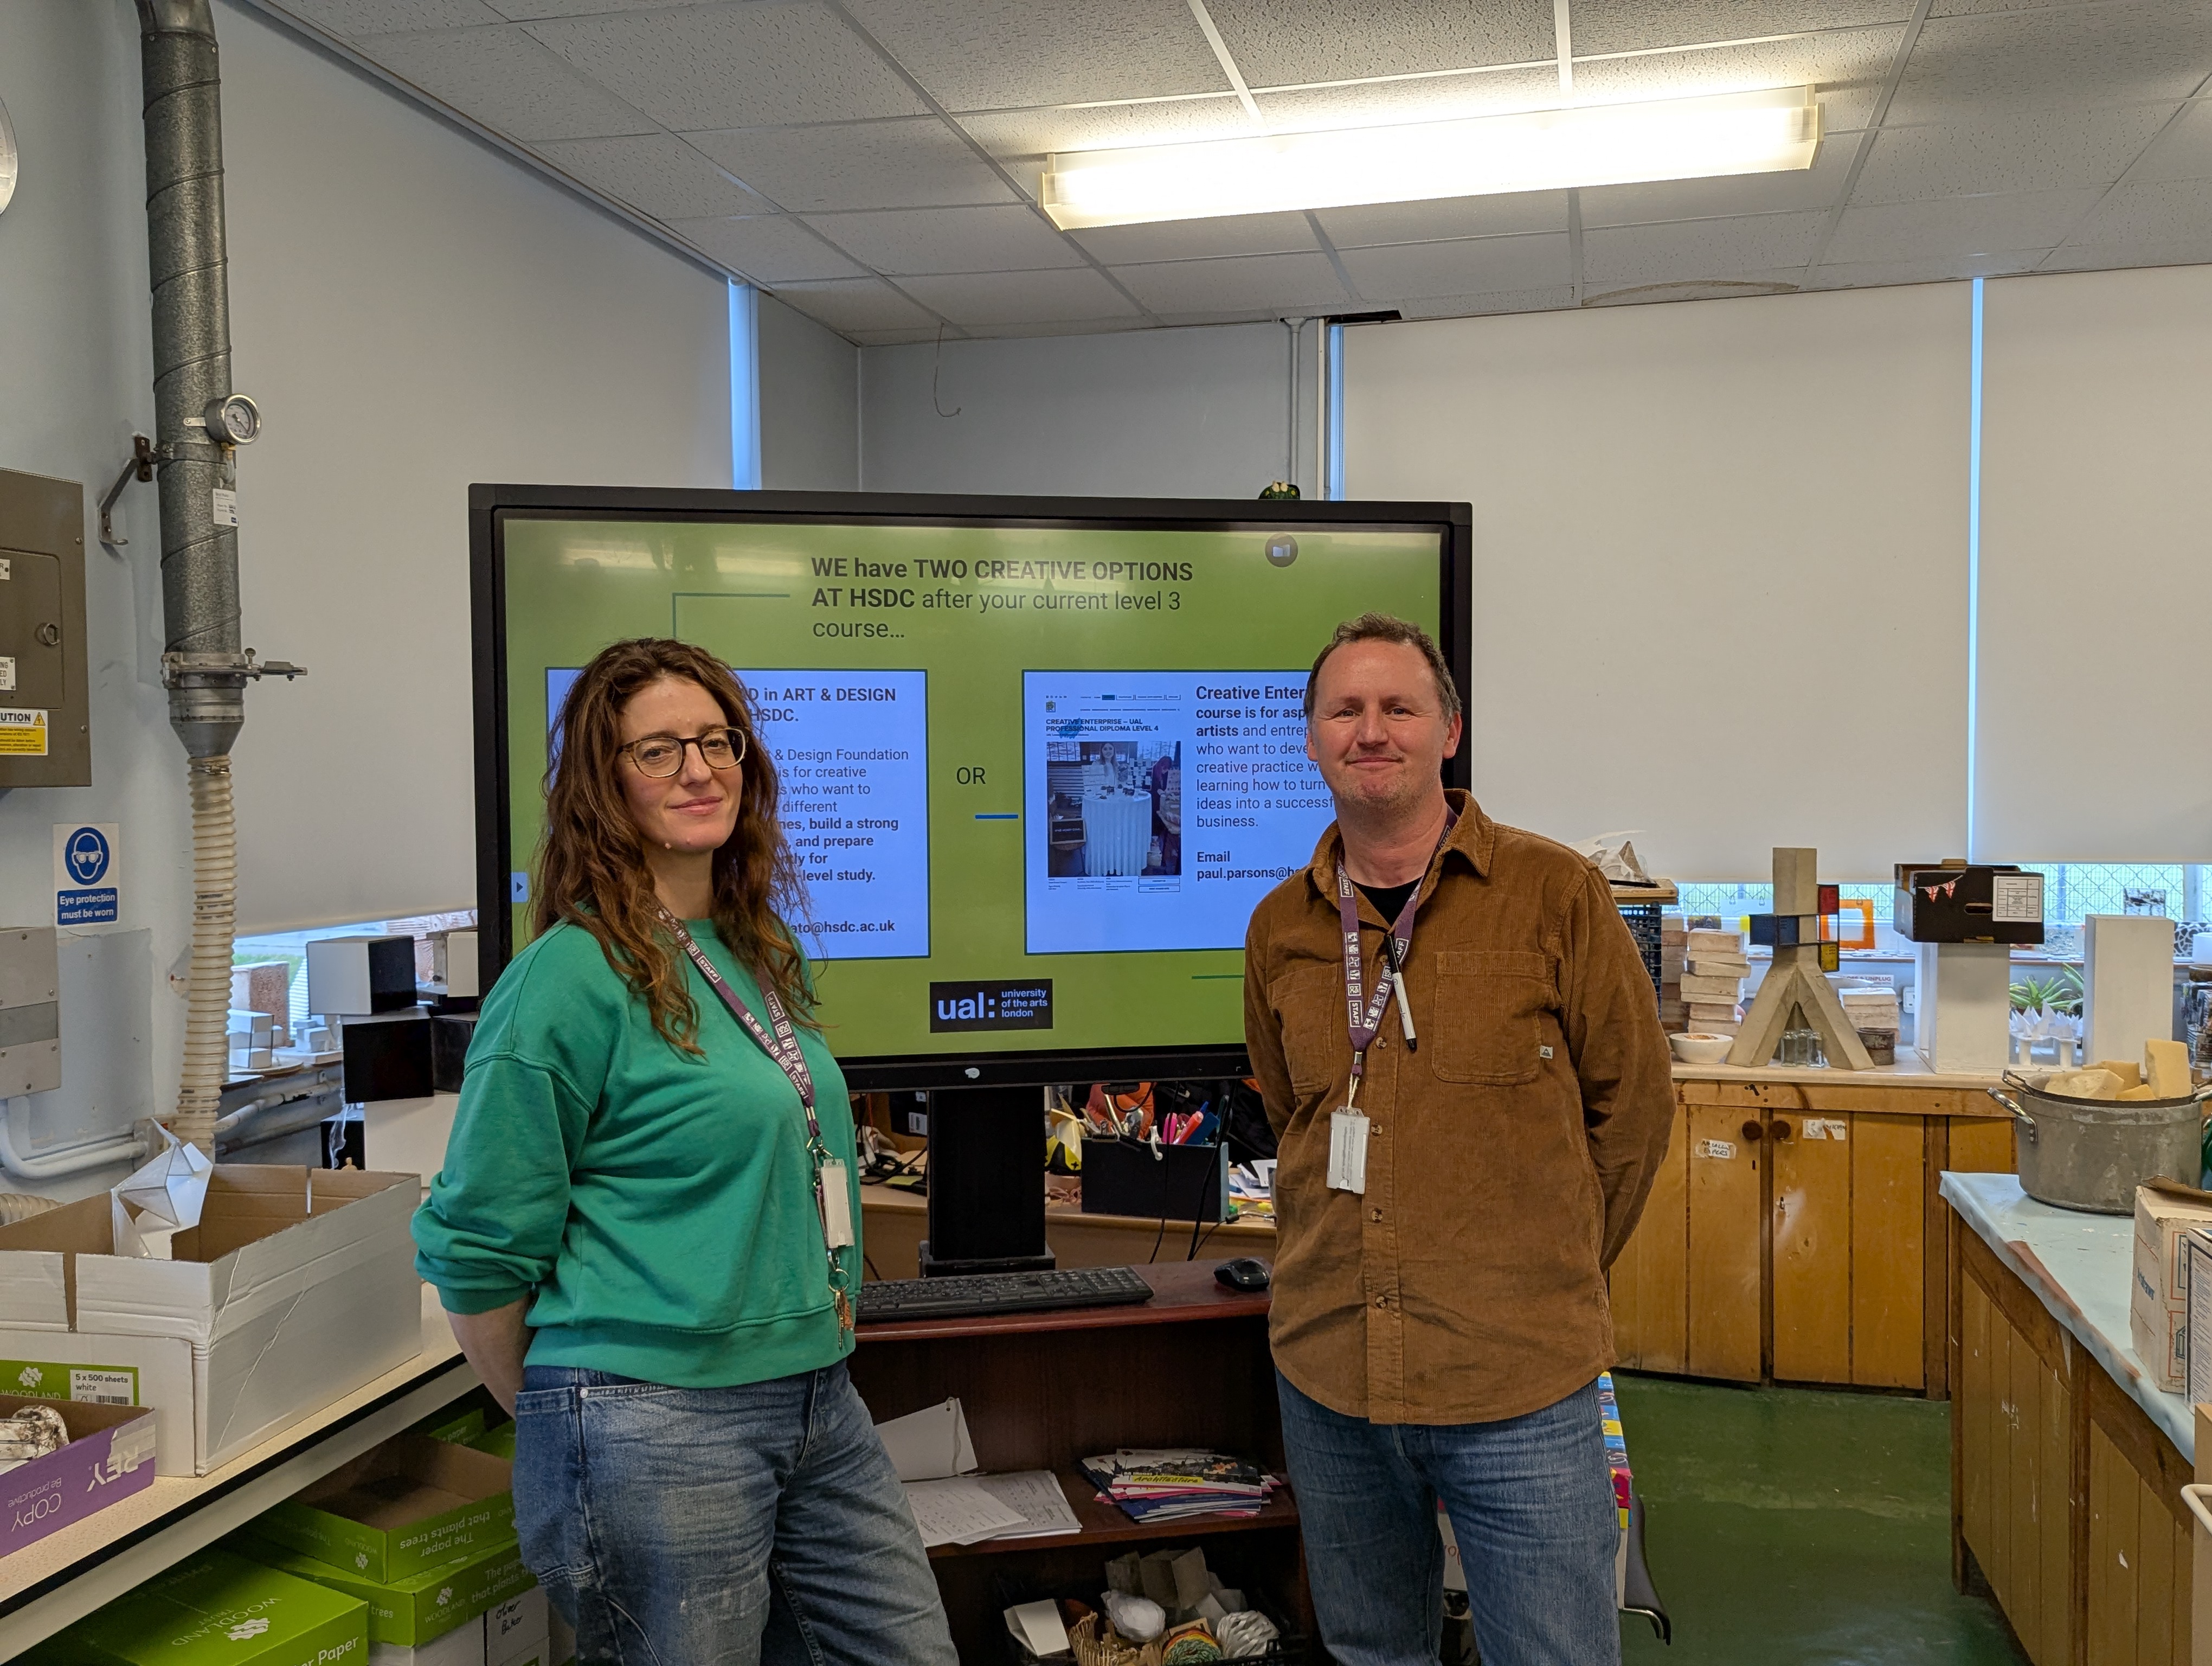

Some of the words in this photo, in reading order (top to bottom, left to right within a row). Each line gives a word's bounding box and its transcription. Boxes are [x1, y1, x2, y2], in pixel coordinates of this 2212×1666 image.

[812, 558, 848, 577] WE
[854, 558, 908, 578] have
[914, 559, 968, 579] TWO
[974, 560, 1086, 580] CREATIVE
[1092, 561, 1193, 581] OPTIONS
[812, 588, 843, 607] AT
[850, 588, 915, 608] HSDC
[922, 588, 973, 609] after
[979, 594, 1026, 613] your
[1033, 592, 1108, 610] current
[1115, 591, 1161, 610] level
[1168, 591, 1180, 610] 3
[764, 687, 778, 701] in
[782, 688, 815, 701] ART
[820, 688, 832, 701] &
[836, 688, 896, 701] DESIGN
[1195, 685, 1260, 700] Creative
[1264, 685, 1307, 700] Enter
[1195, 708, 1242, 719] course
[1245, 706, 1256, 719] is
[1259, 706, 1279, 719] for
[1195, 724, 1239, 737] artists
[1242, 723, 1267, 736] and
[775, 749, 784, 761] &
[787, 748, 832, 763] Design
[836, 748, 909, 761] Foundation
[1196, 742, 1224, 755] who
[1227, 744, 1259, 755] want
[1263, 744, 1276, 755] to
[793, 766, 812, 778] for
[815, 766, 867, 778] creative
[1196, 760, 1249, 773] creative
[1251, 760, 1304, 776] practice
[956, 766, 986, 785] OR
[791, 784, 819, 795] who
[822, 785, 855, 795] want
[858, 785, 871, 795] to
[1196, 779, 1249, 793] learning
[1252, 779, 1280, 791] how
[1283, 779, 1297, 791] to
[1300, 779, 1326, 790] turn
[782, 800, 838, 812] different
[1196, 797, 1232, 810] ideas
[1236, 797, 1260, 809] into
[1264, 800, 1271, 809] a
[809, 817, 841, 830] build
[845, 821, 853, 830] a
[857, 818, 899, 831] strong
[1196, 815, 1259, 828] business.
[795, 835, 820, 848] and
[824, 837, 874, 849] prepare
[809, 852, 828, 864] for
[1197, 850, 1231, 863] Email
[837, 868, 876, 883] study.
[60, 895, 75, 906] Eye
[76, 893, 115, 906] protection
[61, 910, 82, 919] must
[83, 908, 93, 918] be
[94, 908, 114, 917] worn
[699, 959, 718, 978] STAFF
[1001, 989, 1047, 998] university
[768, 996, 781, 1018] STAFF
[1001, 998, 1011, 1008] of
[1013, 999, 1028, 1008] the
[1029, 998, 1048, 1007] arts
[1001, 1009, 1034, 1017] london
[792, 1075, 806, 1097] STAFF
[105, 1375, 128, 1383] sheets
[51, 1477, 62, 1488] Be
[8, 1481, 50, 1508] productive
[11, 1493, 61, 1532] COPY
[467, 1511, 491, 1527] that
[431, 1517, 465, 1539] plants
[400, 1533, 429, 1549] trees
[454, 1532, 474, 1545] The
[420, 1538, 452, 1558] paper
[485, 1567, 502, 1581] The
[472, 1589, 493, 1604] that
[492, 1574, 520, 1595] plants
[371, 1605, 394, 1619] trees
[171, 1597, 282, 1647] WOODLAND
[318, 1637, 359, 1666] Paper
